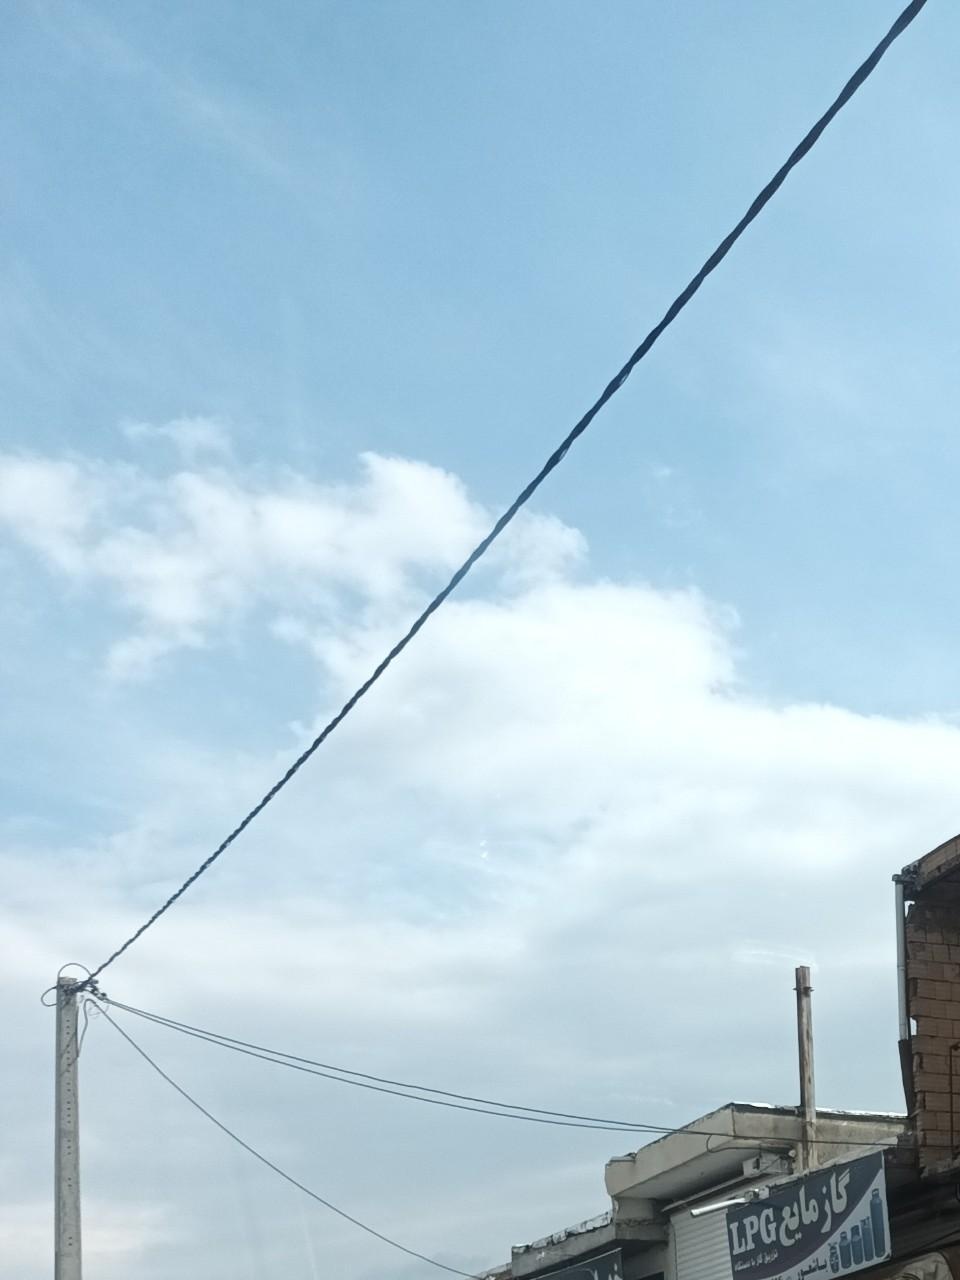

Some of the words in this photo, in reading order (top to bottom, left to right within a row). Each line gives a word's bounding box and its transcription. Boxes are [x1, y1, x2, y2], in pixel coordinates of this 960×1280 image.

[729, 1207, 777, 1255] LPG
[779, 1184, 819, 1247] مایع
[820, 1168, 850, 1233] گاز
